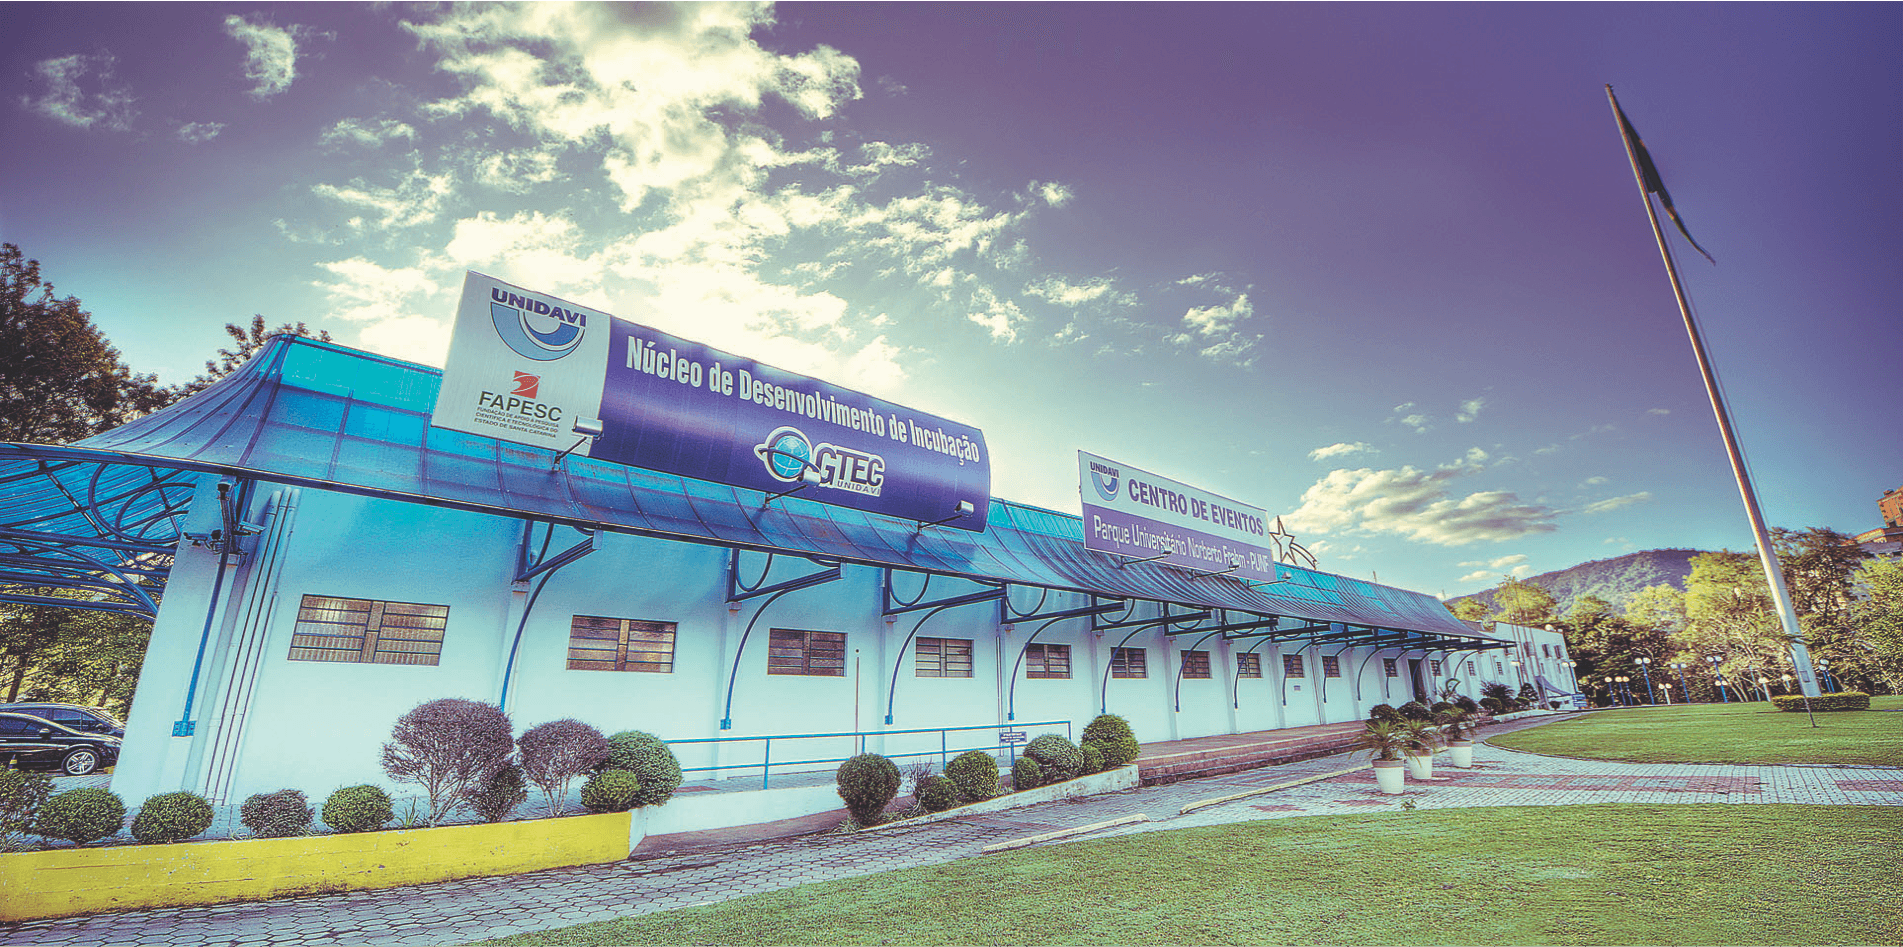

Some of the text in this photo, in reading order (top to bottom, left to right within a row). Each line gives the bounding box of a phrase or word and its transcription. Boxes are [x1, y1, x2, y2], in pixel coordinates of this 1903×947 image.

[491, 287, 587, 327] UNIDAVI
[478, 390, 563, 422] FAPESC
[626, 335, 980, 466] Núcleo de Desenvolvimento de Incubação
[473, 417, 499, 427] ESTADO
[508, 424, 528, 433] SANTA
[815, 446, 883, 488] GTEC
[1089, 461, 1120, 479] UNIDAVI
[837, 481, 880, 495] UNIDAVI
[1128, 478, 1264, 537] CENTRO DE EVENTOS
[1093, 514, 1131, 549] Parque
[1131, 523, 1187, 556] Universitário
[1187, 536, 1223, 564] Norberto
